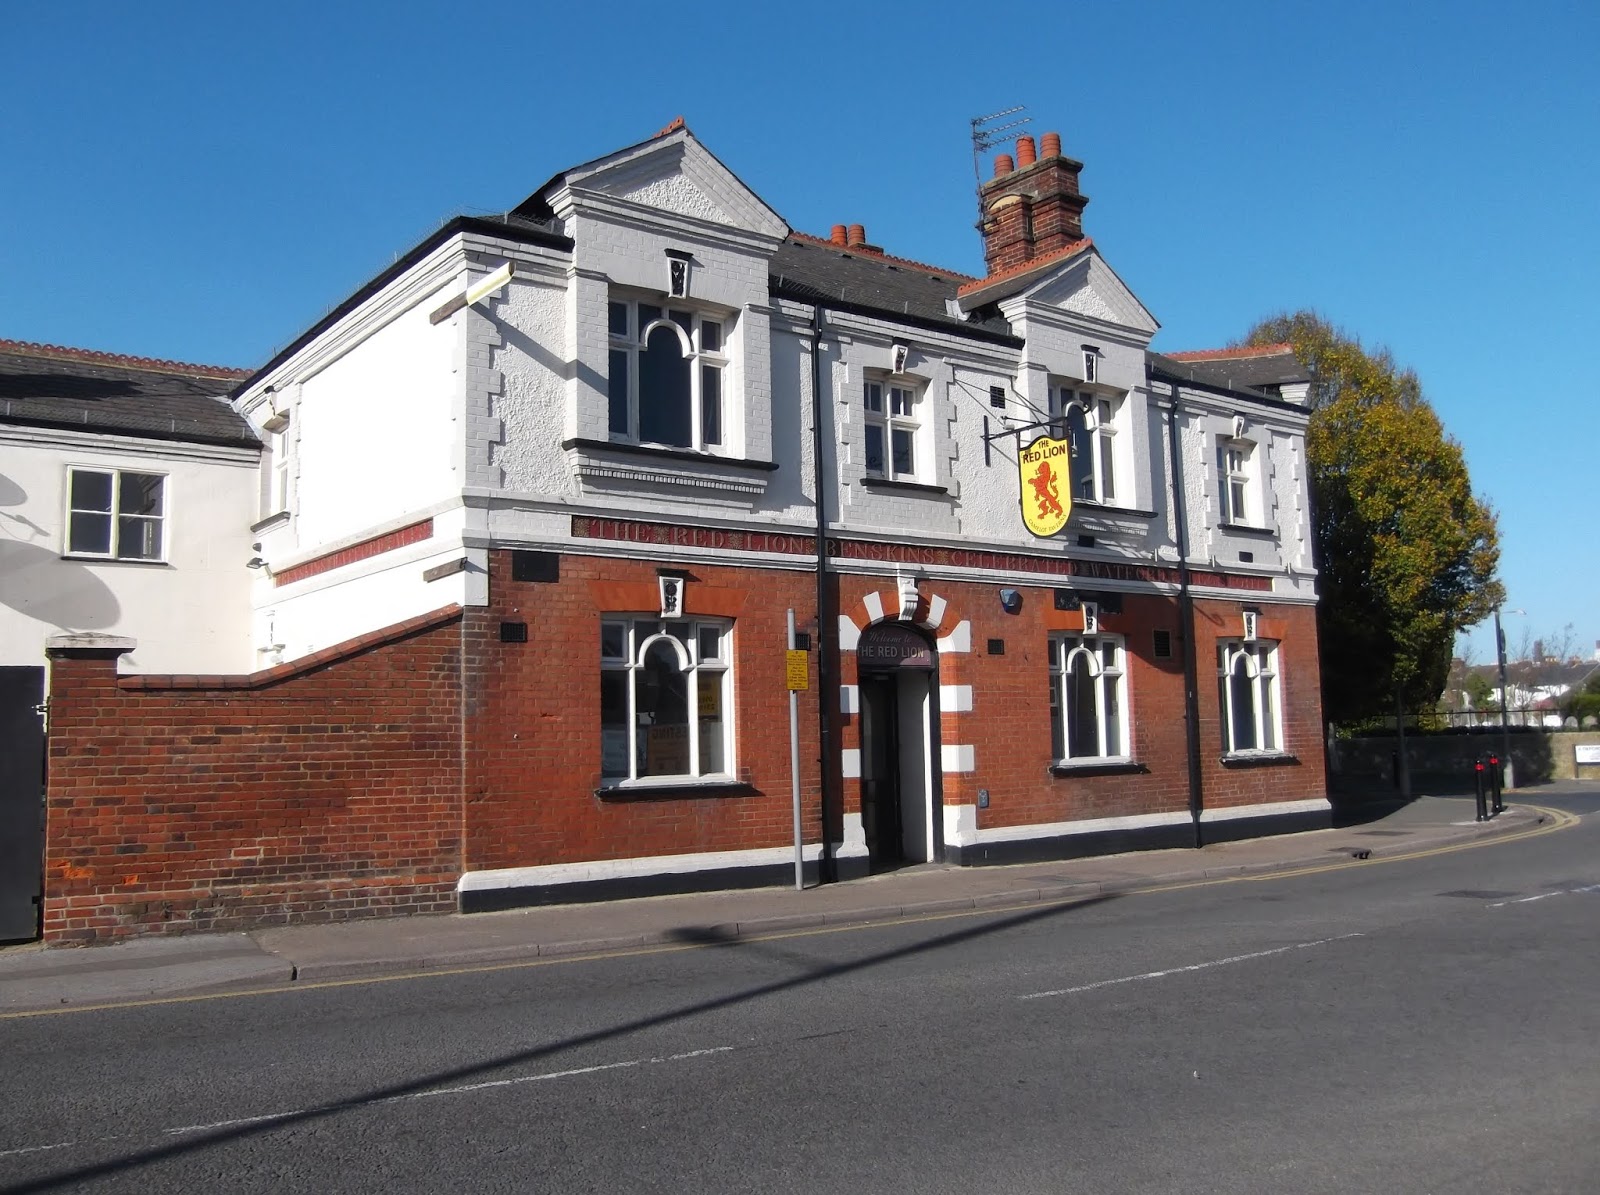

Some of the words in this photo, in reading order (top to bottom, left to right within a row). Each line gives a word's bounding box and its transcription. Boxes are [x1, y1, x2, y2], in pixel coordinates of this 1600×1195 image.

[1038, 440, 1049, 449] THE
[1022, 451, 1041, 464] RED
[1043, 444, 1066, 459] LION
[592, 519, 652, 542] THE
[672, 527, 725, 548] RED
[746, 534, 805, 554] LION
[825, 540, 936, 565] BENSKINS
[951, 550, 1078, 576] CELEBRATED
[1090, 562, 1166, 583] WATFORD
[878, 646, 898, 658] RED
[901, 646, 924, 658] LION
